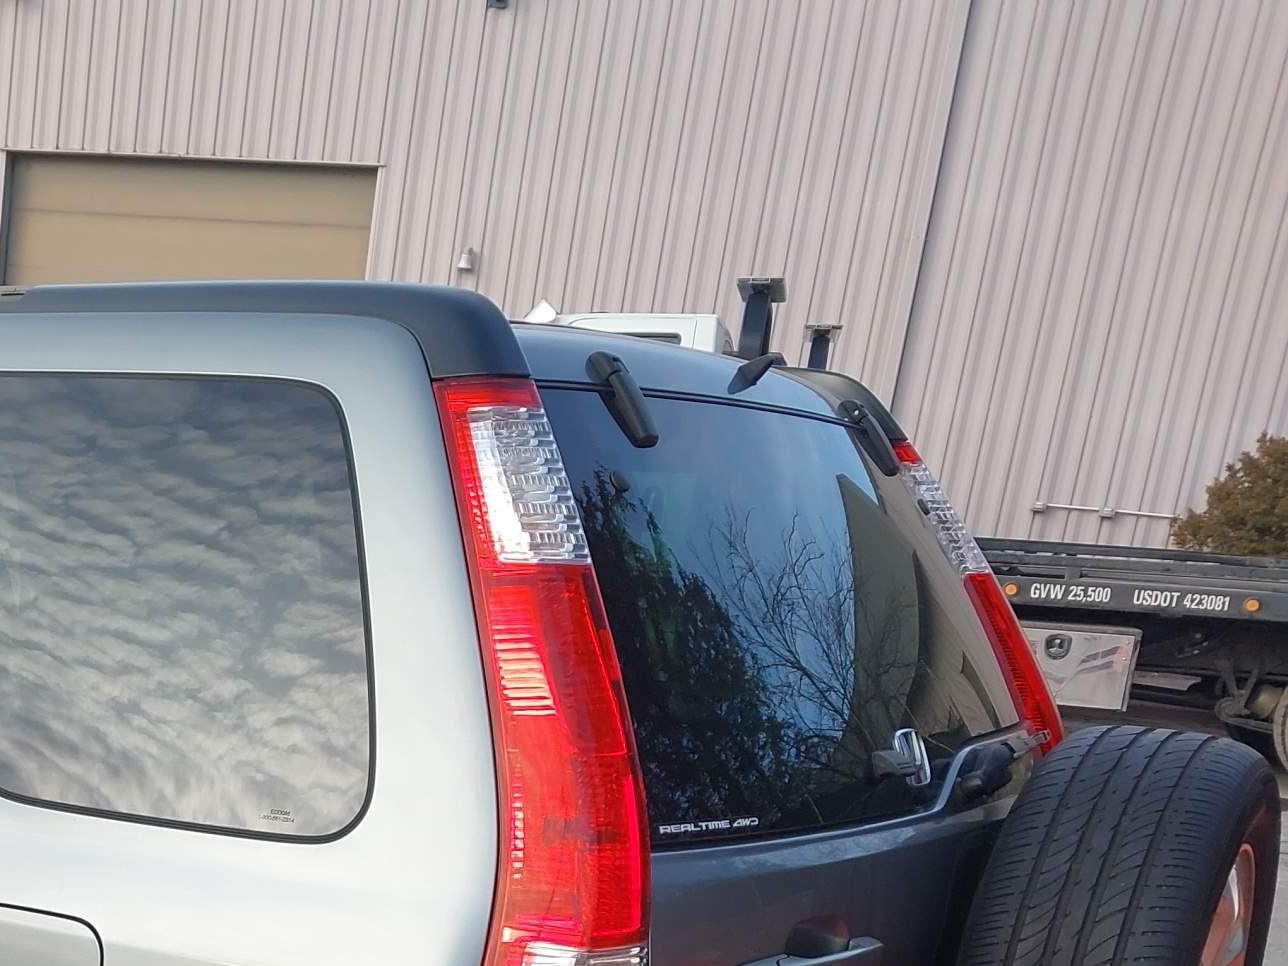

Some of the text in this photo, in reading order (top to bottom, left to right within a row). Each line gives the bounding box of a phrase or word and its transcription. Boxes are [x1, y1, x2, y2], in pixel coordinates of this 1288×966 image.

[1030, 583, 1112, 603] GVW 25,500
[1133, 589, 1230, 612] USDOT 423081
